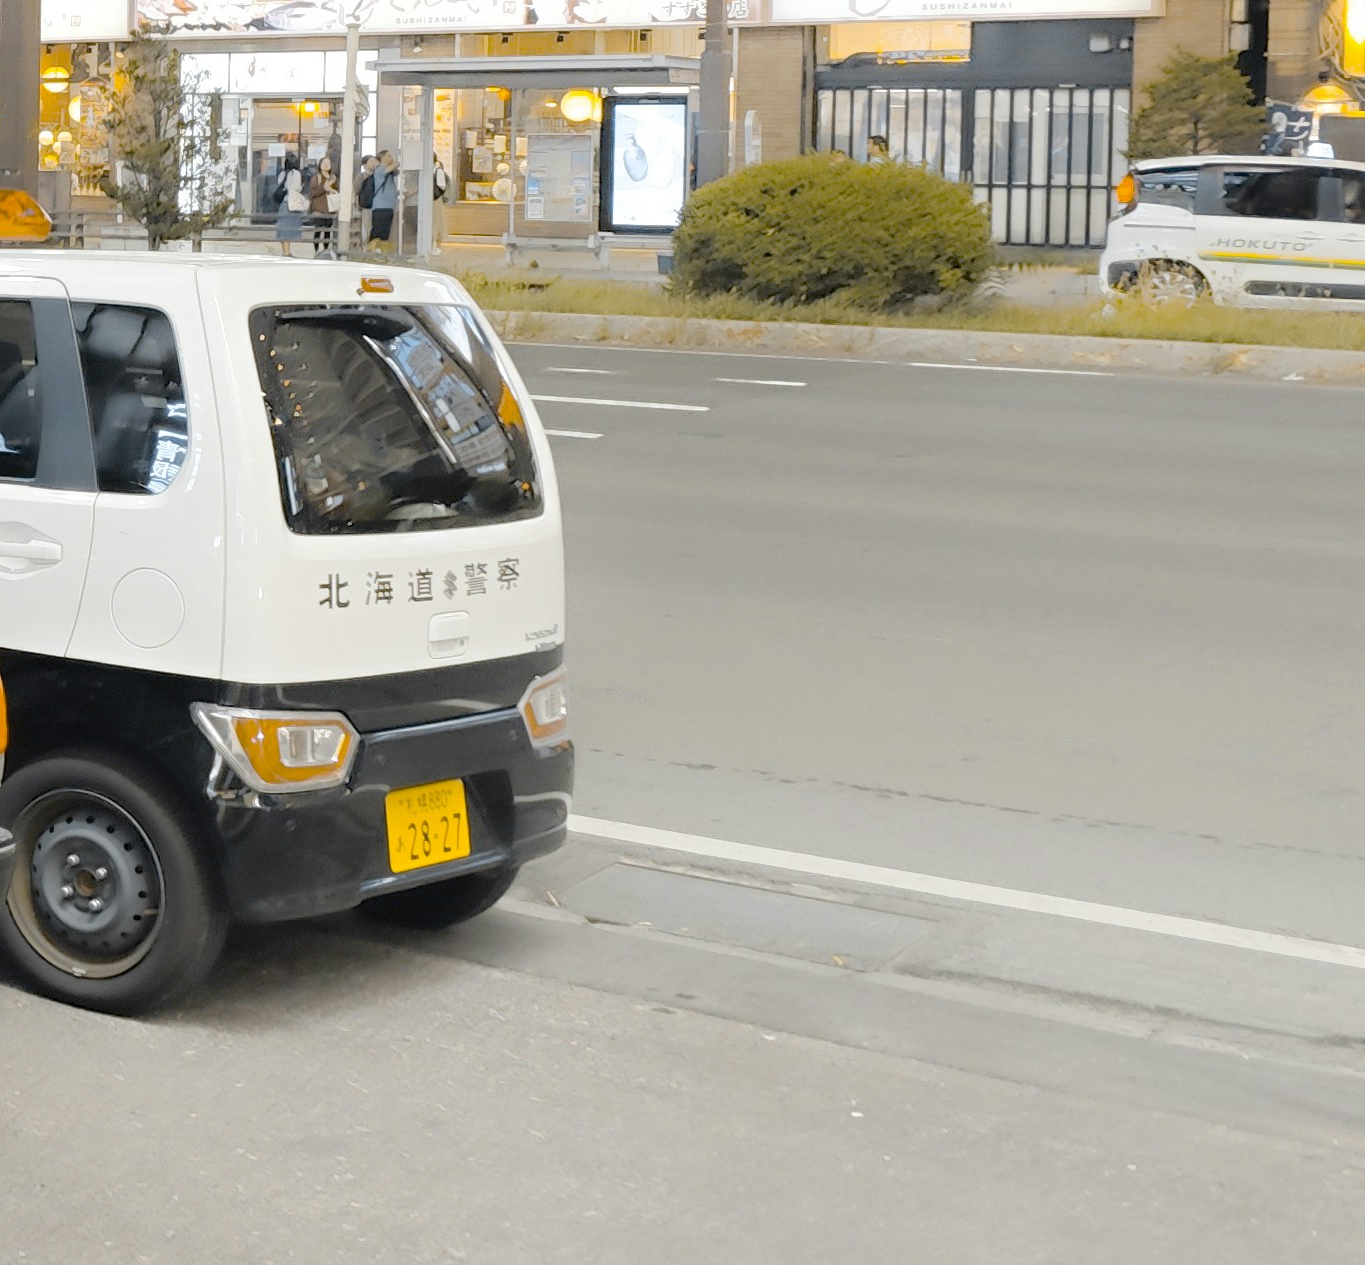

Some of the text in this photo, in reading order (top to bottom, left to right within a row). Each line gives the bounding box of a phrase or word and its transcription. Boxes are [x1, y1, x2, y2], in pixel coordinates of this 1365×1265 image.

[662, 0, 747, 17] すすき店
[922, 1, 1013, 11] SUSHIZANMAI
[319, 557, 520, 609] 北海道 警察
[407, 812, 462, 861] 28-27
